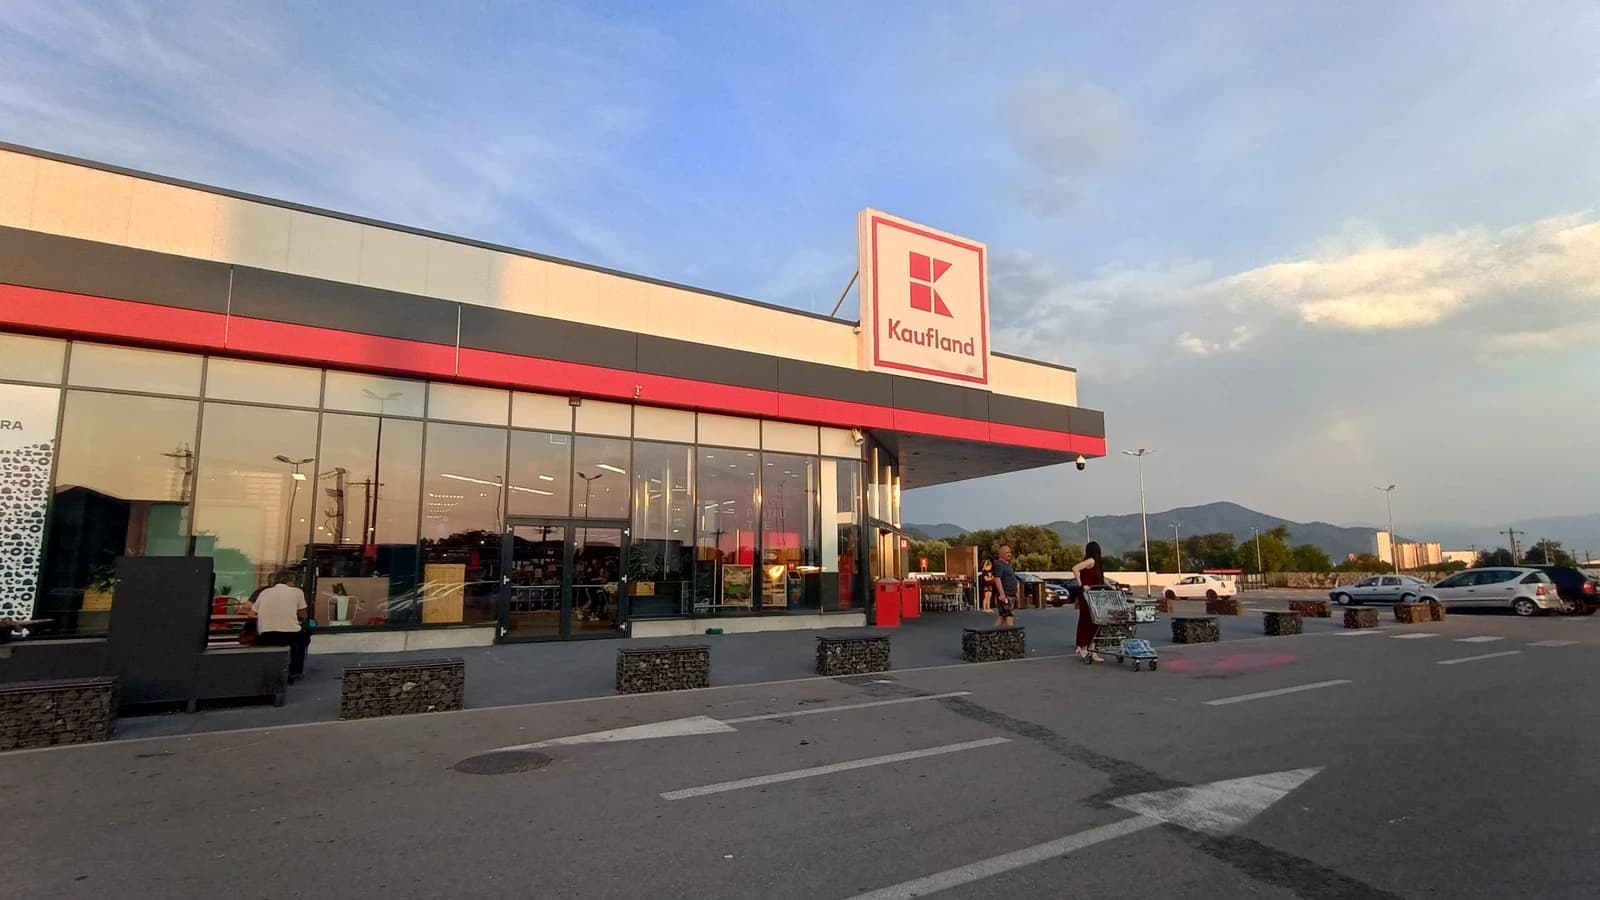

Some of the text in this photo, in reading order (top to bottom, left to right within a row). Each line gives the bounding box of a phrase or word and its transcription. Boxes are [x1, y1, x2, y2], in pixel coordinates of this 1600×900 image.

[909, 251, 954, 318] K
[888, 318, 975, 357] Kaufland
[0, 420, 23, 430] RA
